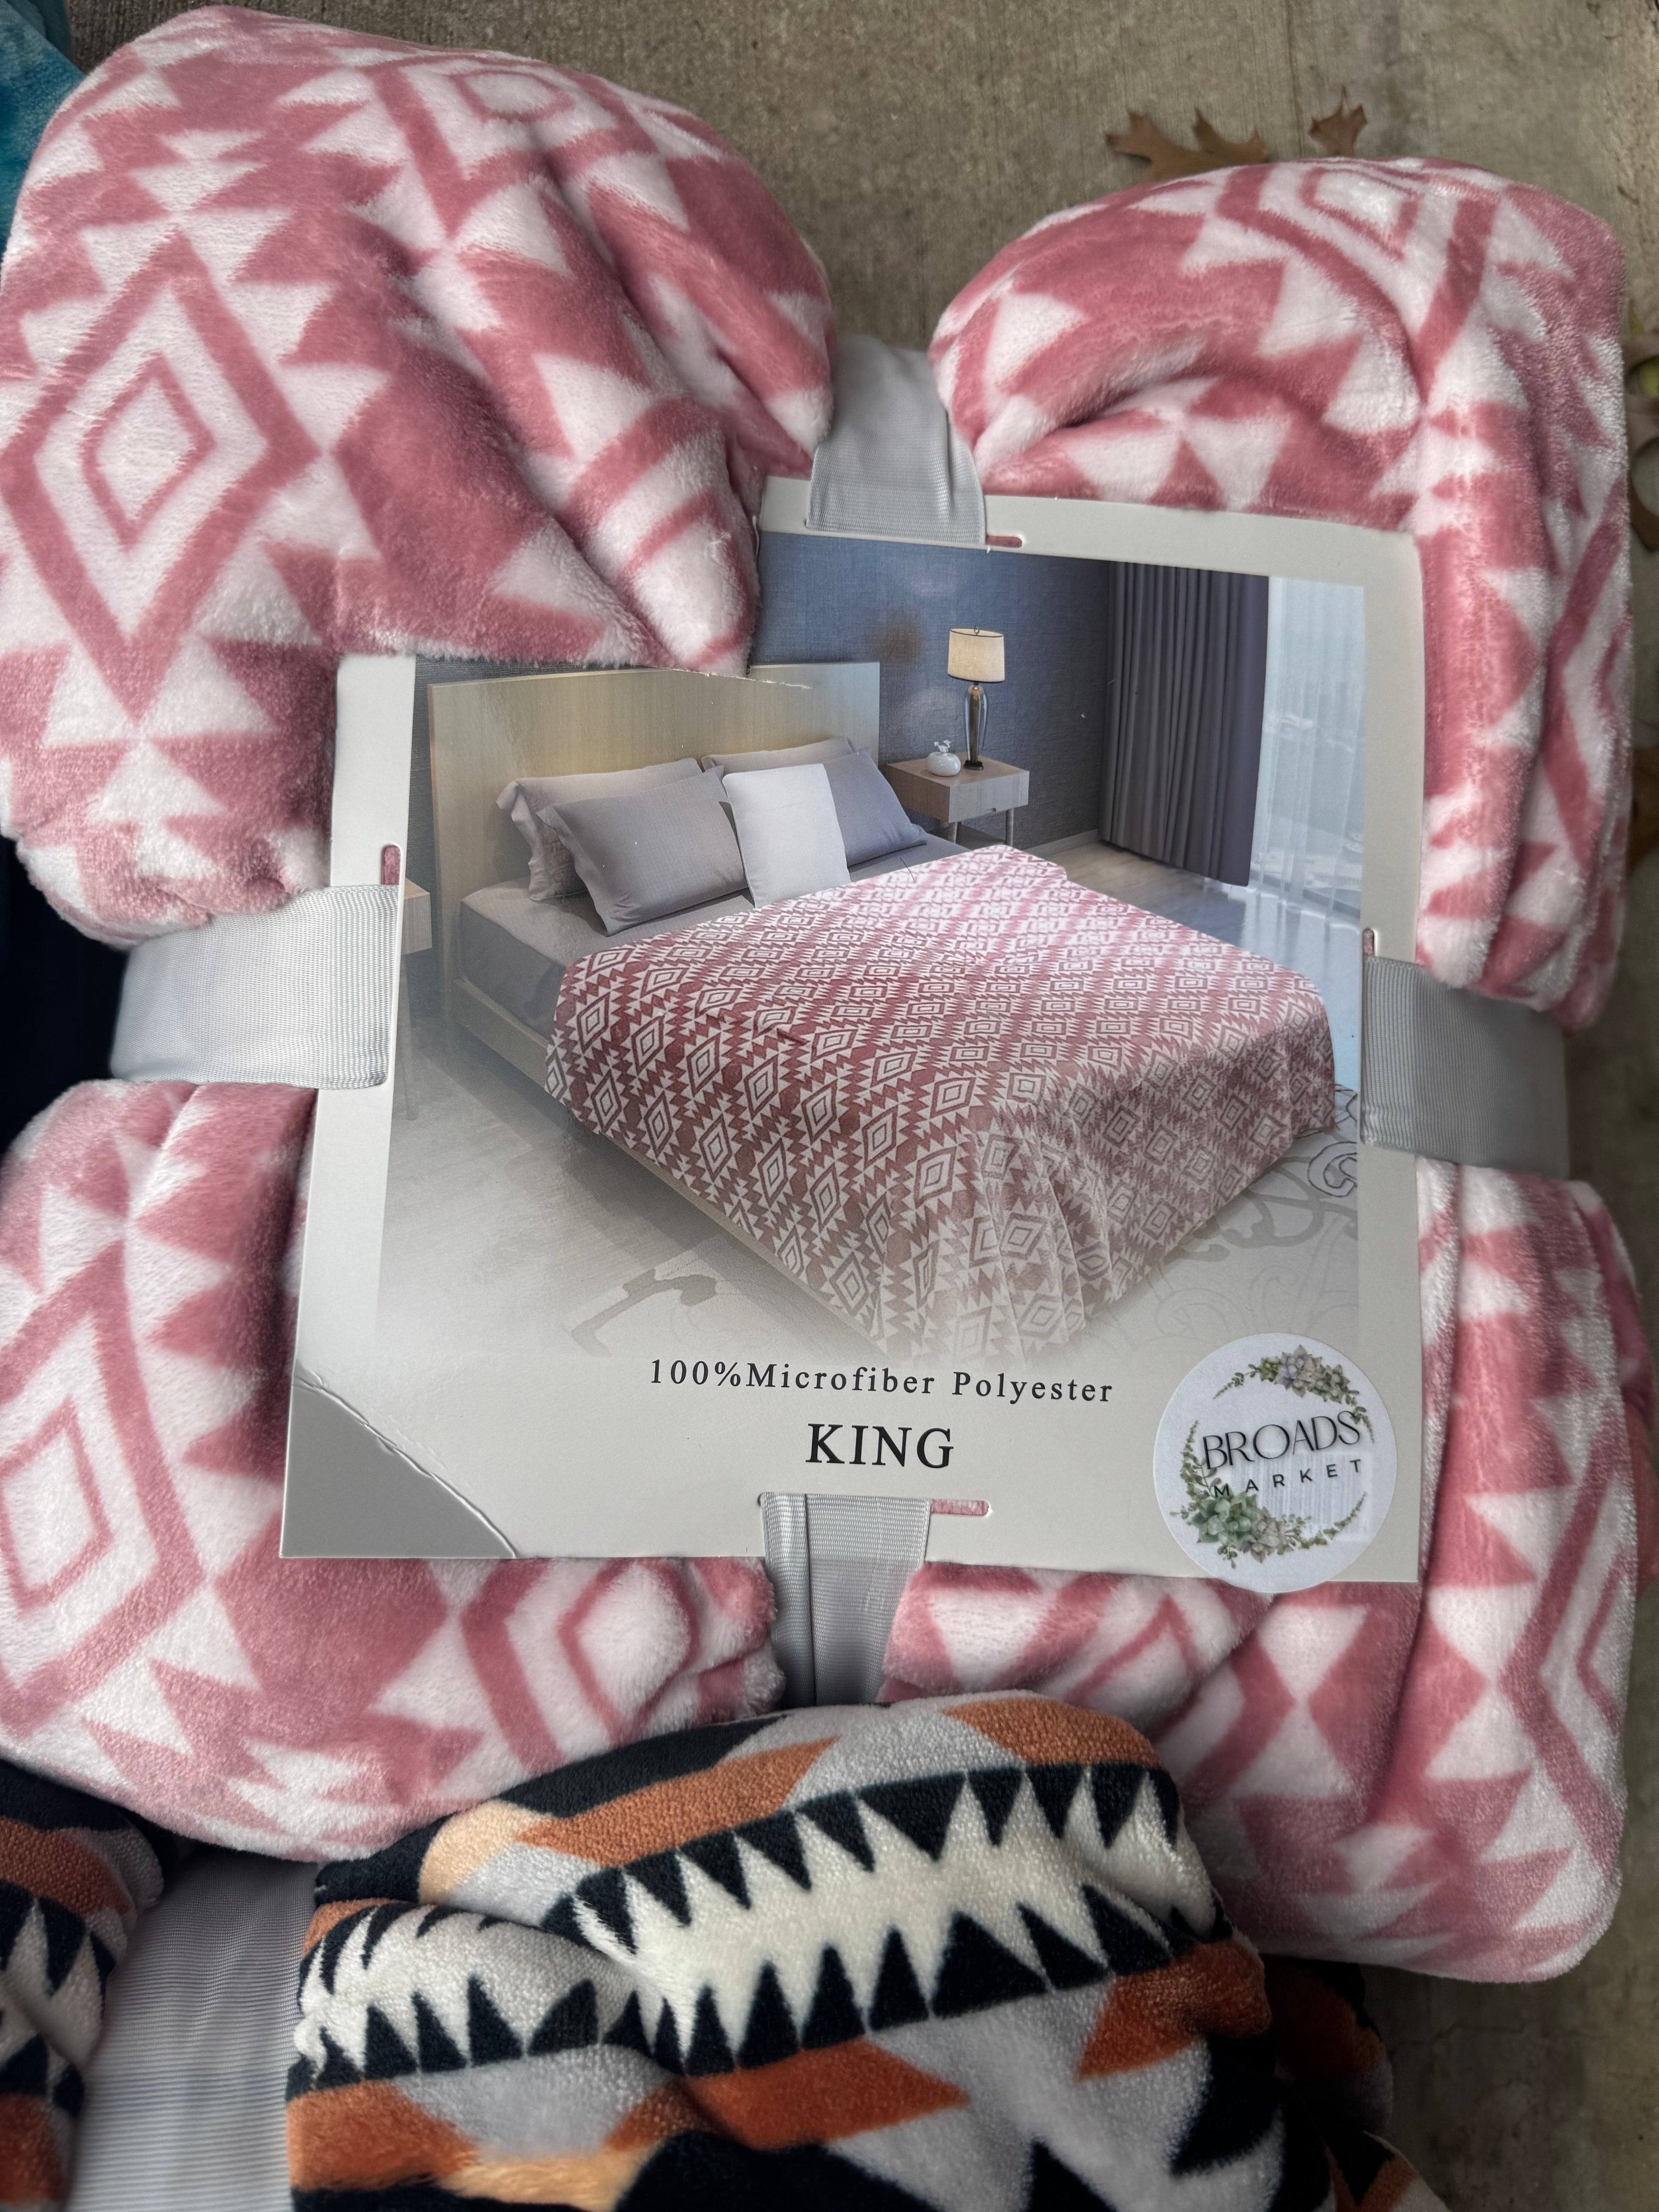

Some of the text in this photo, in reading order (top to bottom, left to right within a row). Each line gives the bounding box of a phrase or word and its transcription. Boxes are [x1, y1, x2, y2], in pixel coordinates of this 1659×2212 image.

[651, 1359, 1113, 1405] 100%Microfiber Polyester
[805, 1423, 954, 1469] KING
[1202, 1411, 1360, 1469] BROADS
[1214, 1459, 1362, 1498] MARKET
